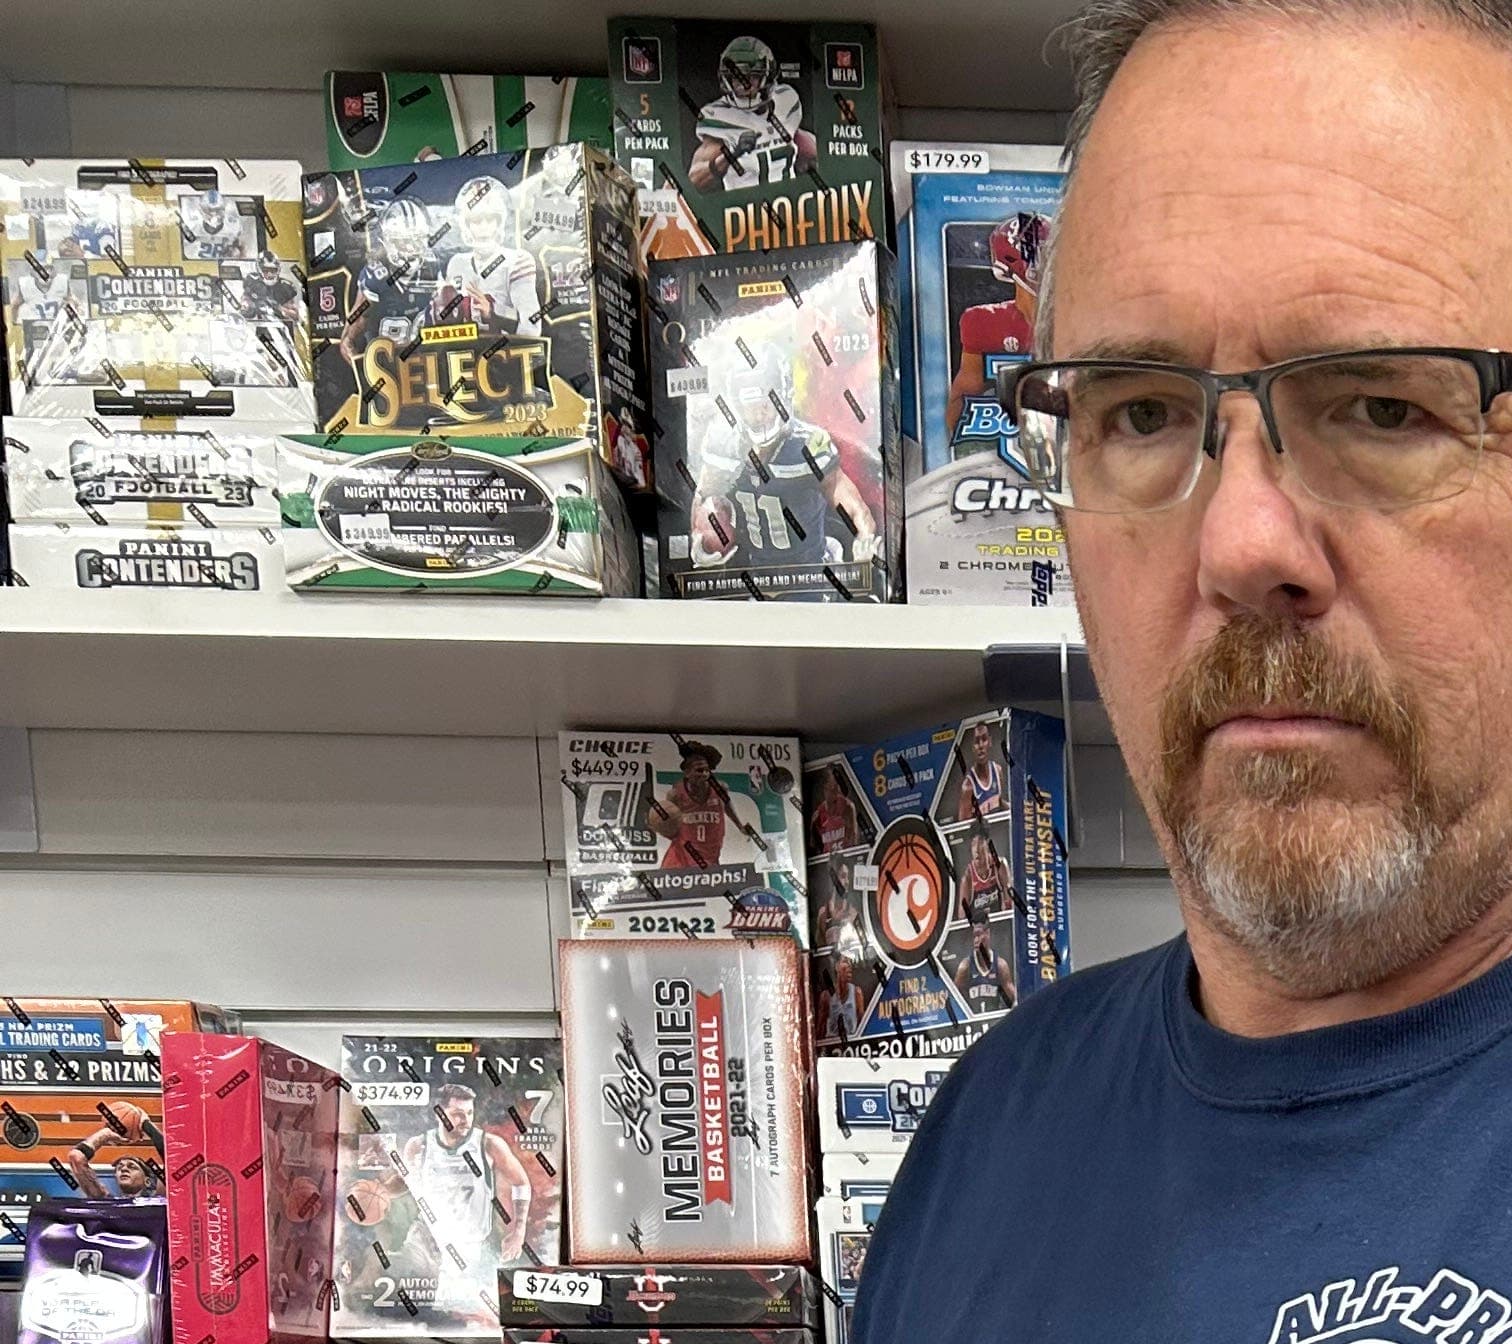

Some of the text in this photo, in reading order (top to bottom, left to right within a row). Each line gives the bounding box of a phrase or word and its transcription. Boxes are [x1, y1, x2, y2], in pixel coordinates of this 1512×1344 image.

[632, 119, 661, 133] CARDS
[833, 125, 863, 138] PACKS
[625, 137, 669, 150] PER PACK
[828, 142, 869, 156] PER BOX
[911, 153, 982, 169] $179.99
[724, 180, 874, 254] PHOENIX
[97, 275, 213, 299] CONTENDERS
[424, 327, 475, 341] PANINI
[833, 335, 869, 351] 2023
[363, 338, 544, 426] SELECT
[504, 404, 547, 423] 2023
[344, 486, 384, 499] NIGHT
[388, 487, 440, 501] MOVES,
[443, 487, 469, 499] THE
[382, 500, 440, 513] RADICAL
[124, 542, 207, 557] PANINI
[77, 551, 256, 590] CONTENDERS
[569, 740, 653, 755] CHOICE
[571, 758, 640, 777] $449.99
[1027, 879, 1038, 905] THE
[629, 916, 715, 933] 2021-22
[1027, 935, 1039, 965] LOOK
[762, 1016, 773, 1038] BOX
[8, 1031, 102, 1048] TRADING CARDS
[438, 1044, 473, 1052] PANINI
[764, 1041, 774, 1063] PER
[363, 1055, 545, 1075] ORIGINS
[357, 1085, 424, 1102] $374.99
[700, 1015, 725, 1182] BASKETBALL
[728, 1056, 748, 1138] 2021-22
[765, 1073, 776, 1109] CARDS
[602, 1052, 656, 1156] Leaf
[653, 978, 704, 1224] MEMORIES
[767, 1112, 780, 1167] AUTOGRAPH
[526, 1274, 589, 1298] $74.99
